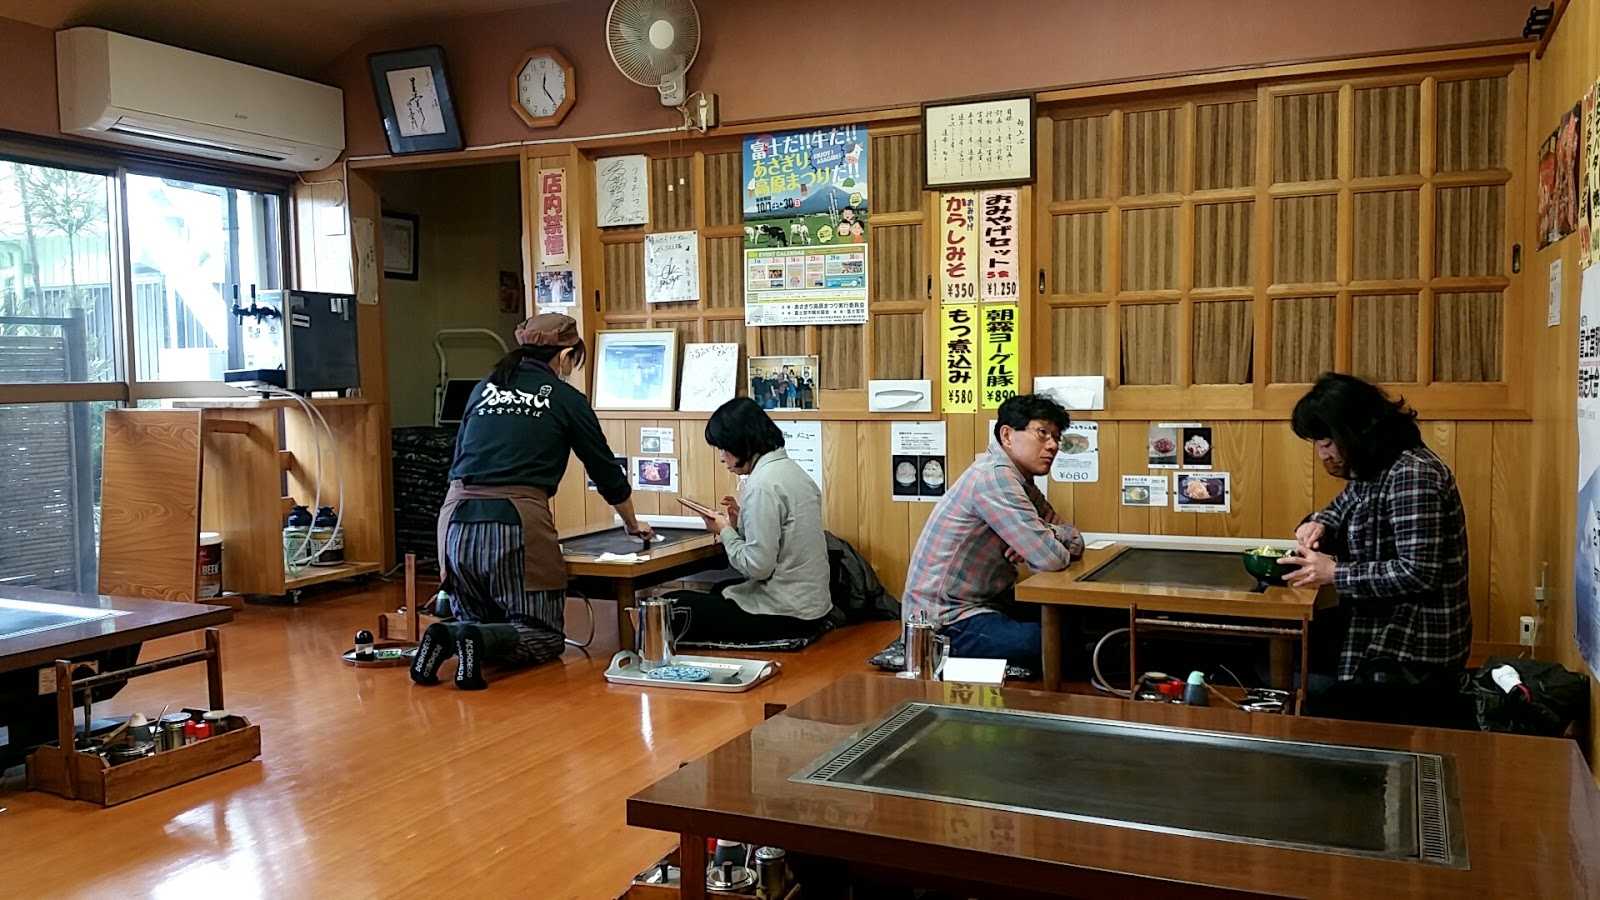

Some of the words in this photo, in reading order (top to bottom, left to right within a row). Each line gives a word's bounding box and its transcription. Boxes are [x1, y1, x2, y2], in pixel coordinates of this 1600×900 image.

[753, 151, 809, 178] あさぎり
[945, 196, 967, 278] からしみそ
[985, 194, 1012, 269] おみやげセット
[947, 282, 974, 298] ¥350
[947, 308, 973, 384] もつ煮込み
[985, 308, 1015, 387] 朝霧ヨーグル豚
[948, 389, 973, 404] ¥580
[1059, 471, 1089, 480] ¥680
